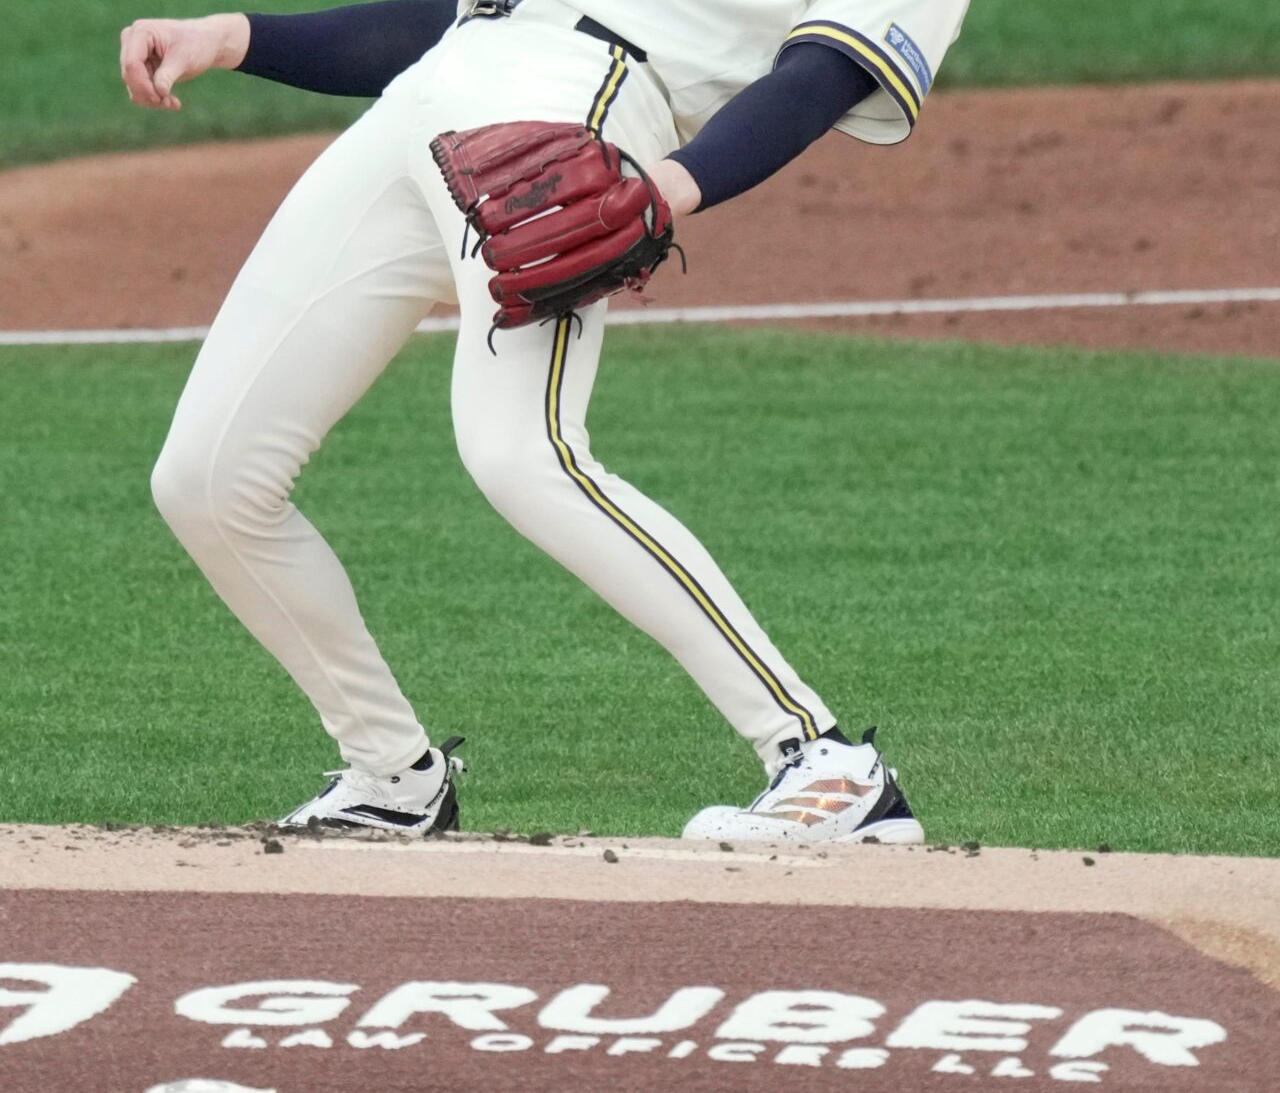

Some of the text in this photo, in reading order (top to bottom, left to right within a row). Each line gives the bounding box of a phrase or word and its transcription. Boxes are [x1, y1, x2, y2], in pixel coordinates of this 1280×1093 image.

[175, 980, 1227, 1066] GRUBER
[221, 1028, 1110, 1083] LAW OFFICES LLC
